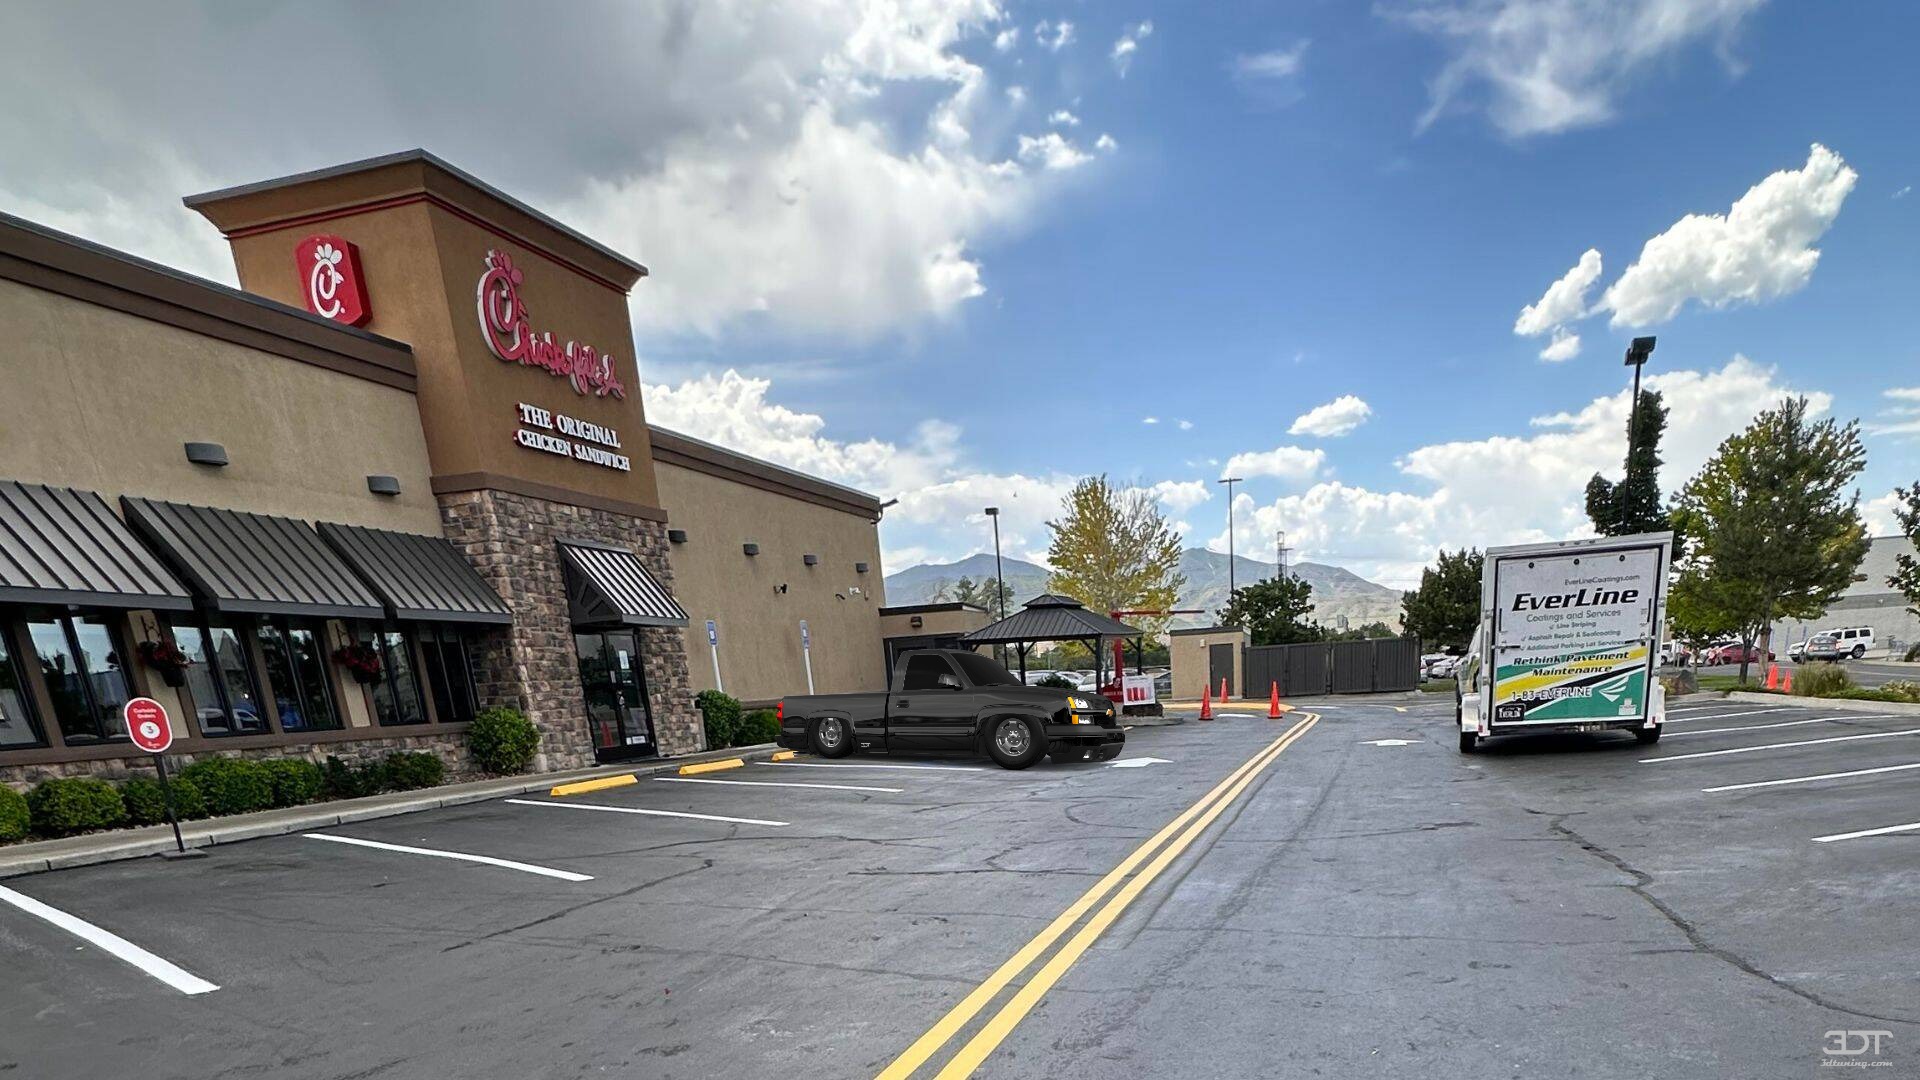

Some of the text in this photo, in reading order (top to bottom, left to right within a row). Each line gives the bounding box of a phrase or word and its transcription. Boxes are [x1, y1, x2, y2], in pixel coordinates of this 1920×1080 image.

[519, 402, 622, 449] THE ORIGINAL
[516, 429, 631, 471] CHICKEN SANDWICH
[1564, 574, 1641, 586] EverLineCoatings.com
[1511, 587, 1640, 612] EverLine
[1526, 609, 1622, 623] Coatings and Services
[1571, 621, 1597, 629] Striping
[1554, 632, 1575, 640] Repair
[1513, 651, 1630, 666] Rethink Pavement
[1532, 664, 1613, 677] Maintenance
[145, 725, 154, 734] 3
